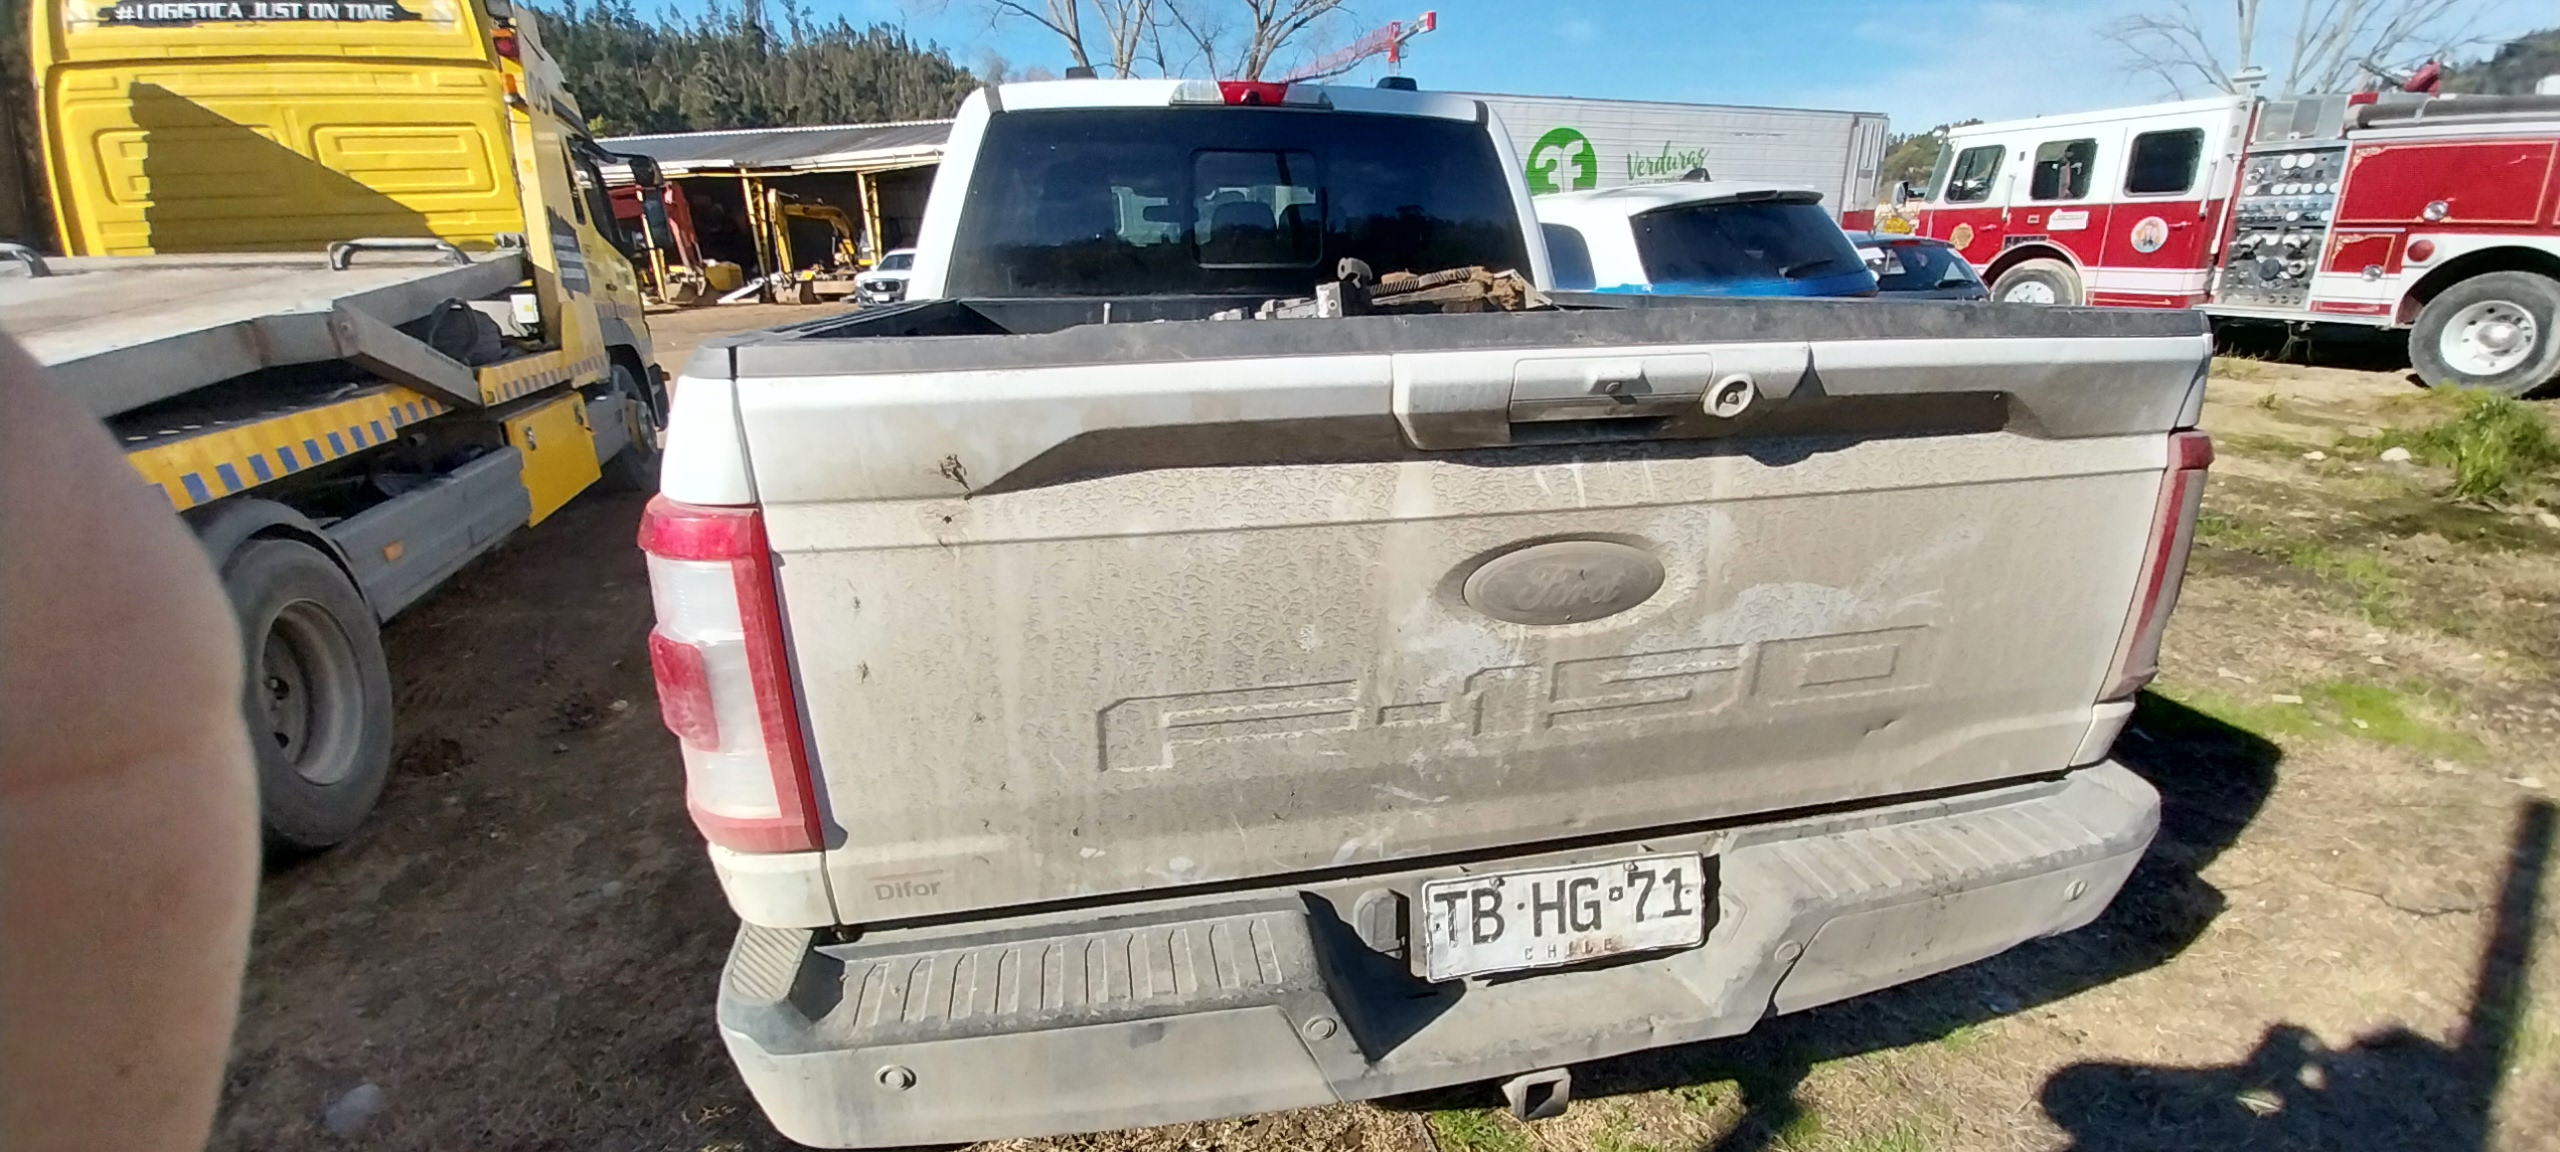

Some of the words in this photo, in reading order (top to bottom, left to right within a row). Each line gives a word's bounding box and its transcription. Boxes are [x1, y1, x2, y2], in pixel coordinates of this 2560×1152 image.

[249, 2, 303, 19] JUST
[308, 3, 340, 19] ON
[344, 4, 396, 20] TIME
[1626, 140, 1710, 180] Verduras
[873, 881, 942, 901] Difor
[1523, 937, 1614, 961] CHILE
